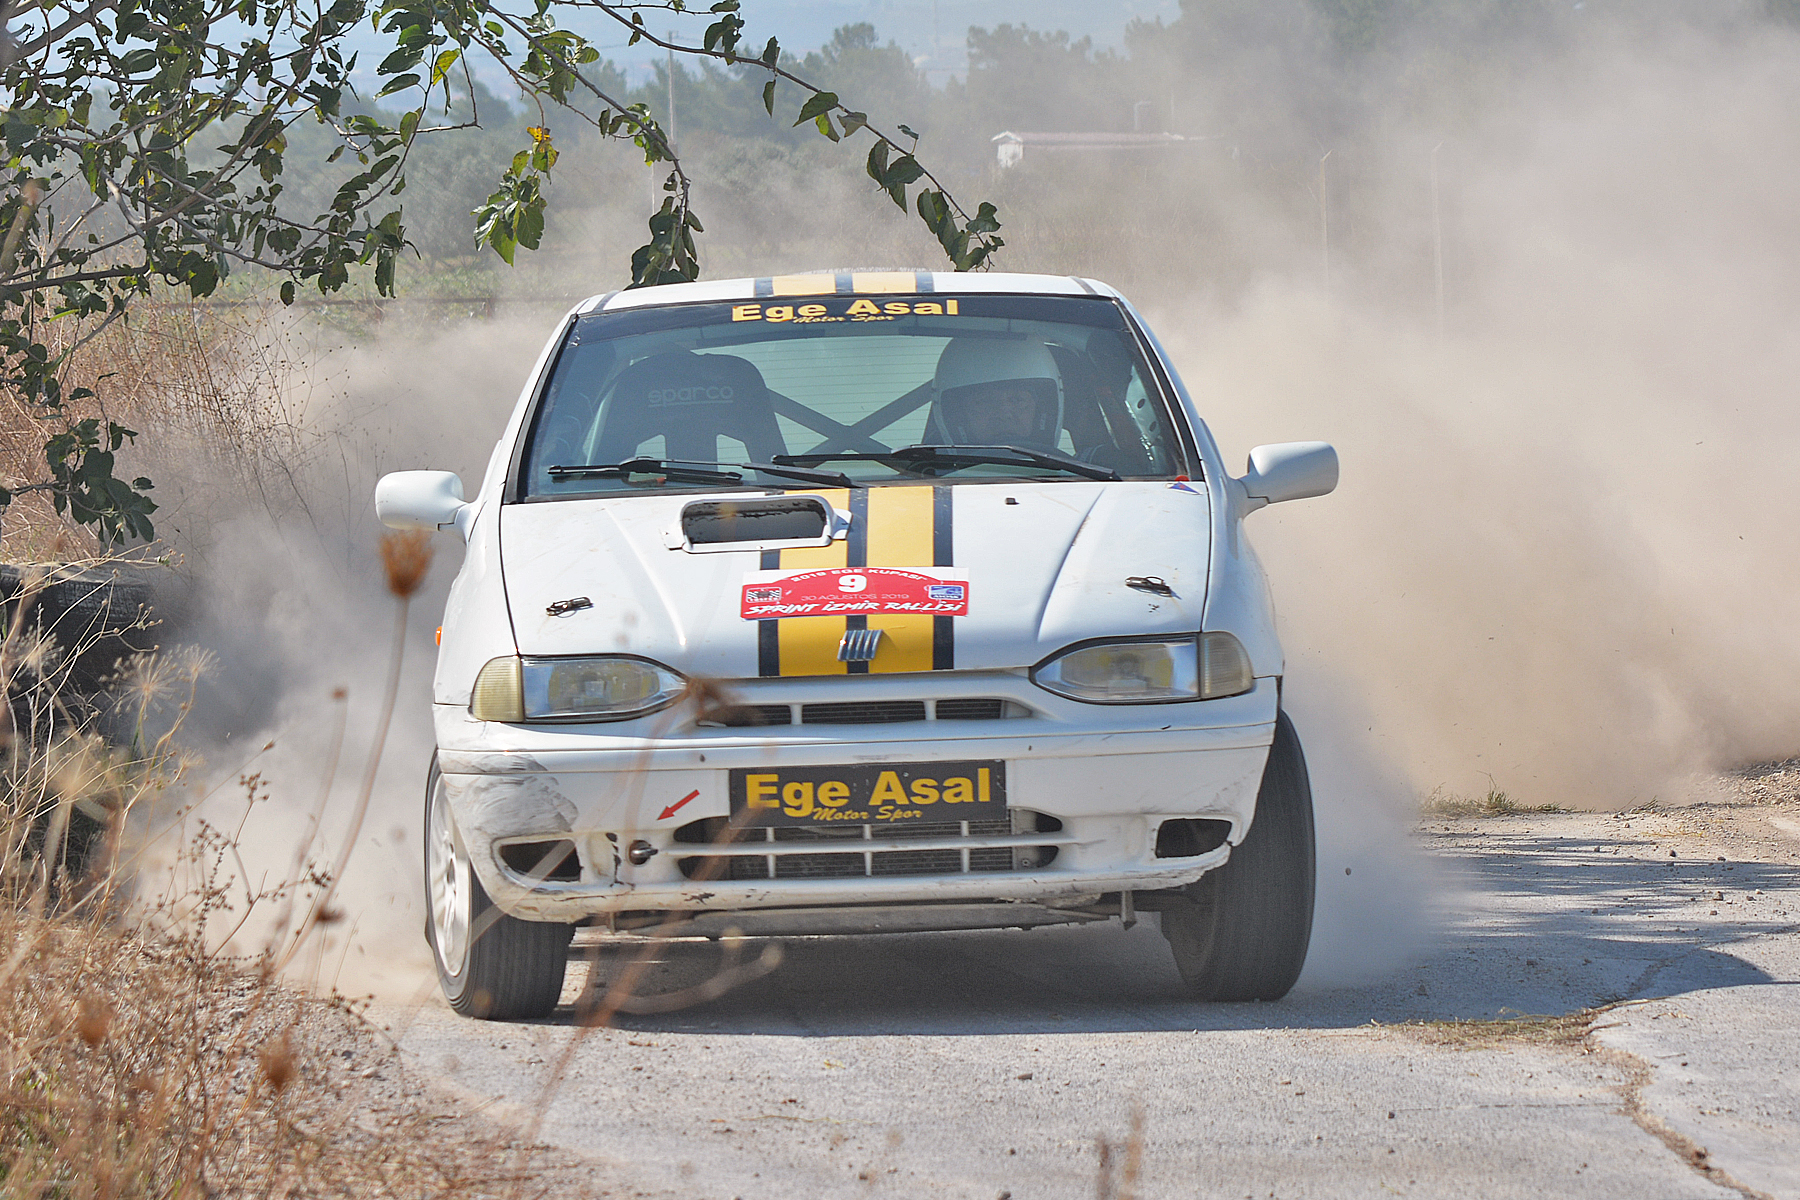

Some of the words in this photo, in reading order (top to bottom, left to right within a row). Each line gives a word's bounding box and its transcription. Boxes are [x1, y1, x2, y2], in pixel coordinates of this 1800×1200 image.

[731, 303, 827, 323] Ege
[845, 299, 959, 316] Asal
[792, 314, 845, 324] Motor
[850, 313, 895, 323] Spor
[648, 386, 734, 408] sparco
[790, 571, 827, 583] 2019
[838, 574, 867, 593] 9
[744, 602, 821, 615] SPRINT
[821, 600, 881, 611] İZMİR
[745, 773, 851, 818] Ege
[868, 767, 991, 807] Asal
[812, 807, 870, 822] Motor
[875, 805, 922, 822] Spor
